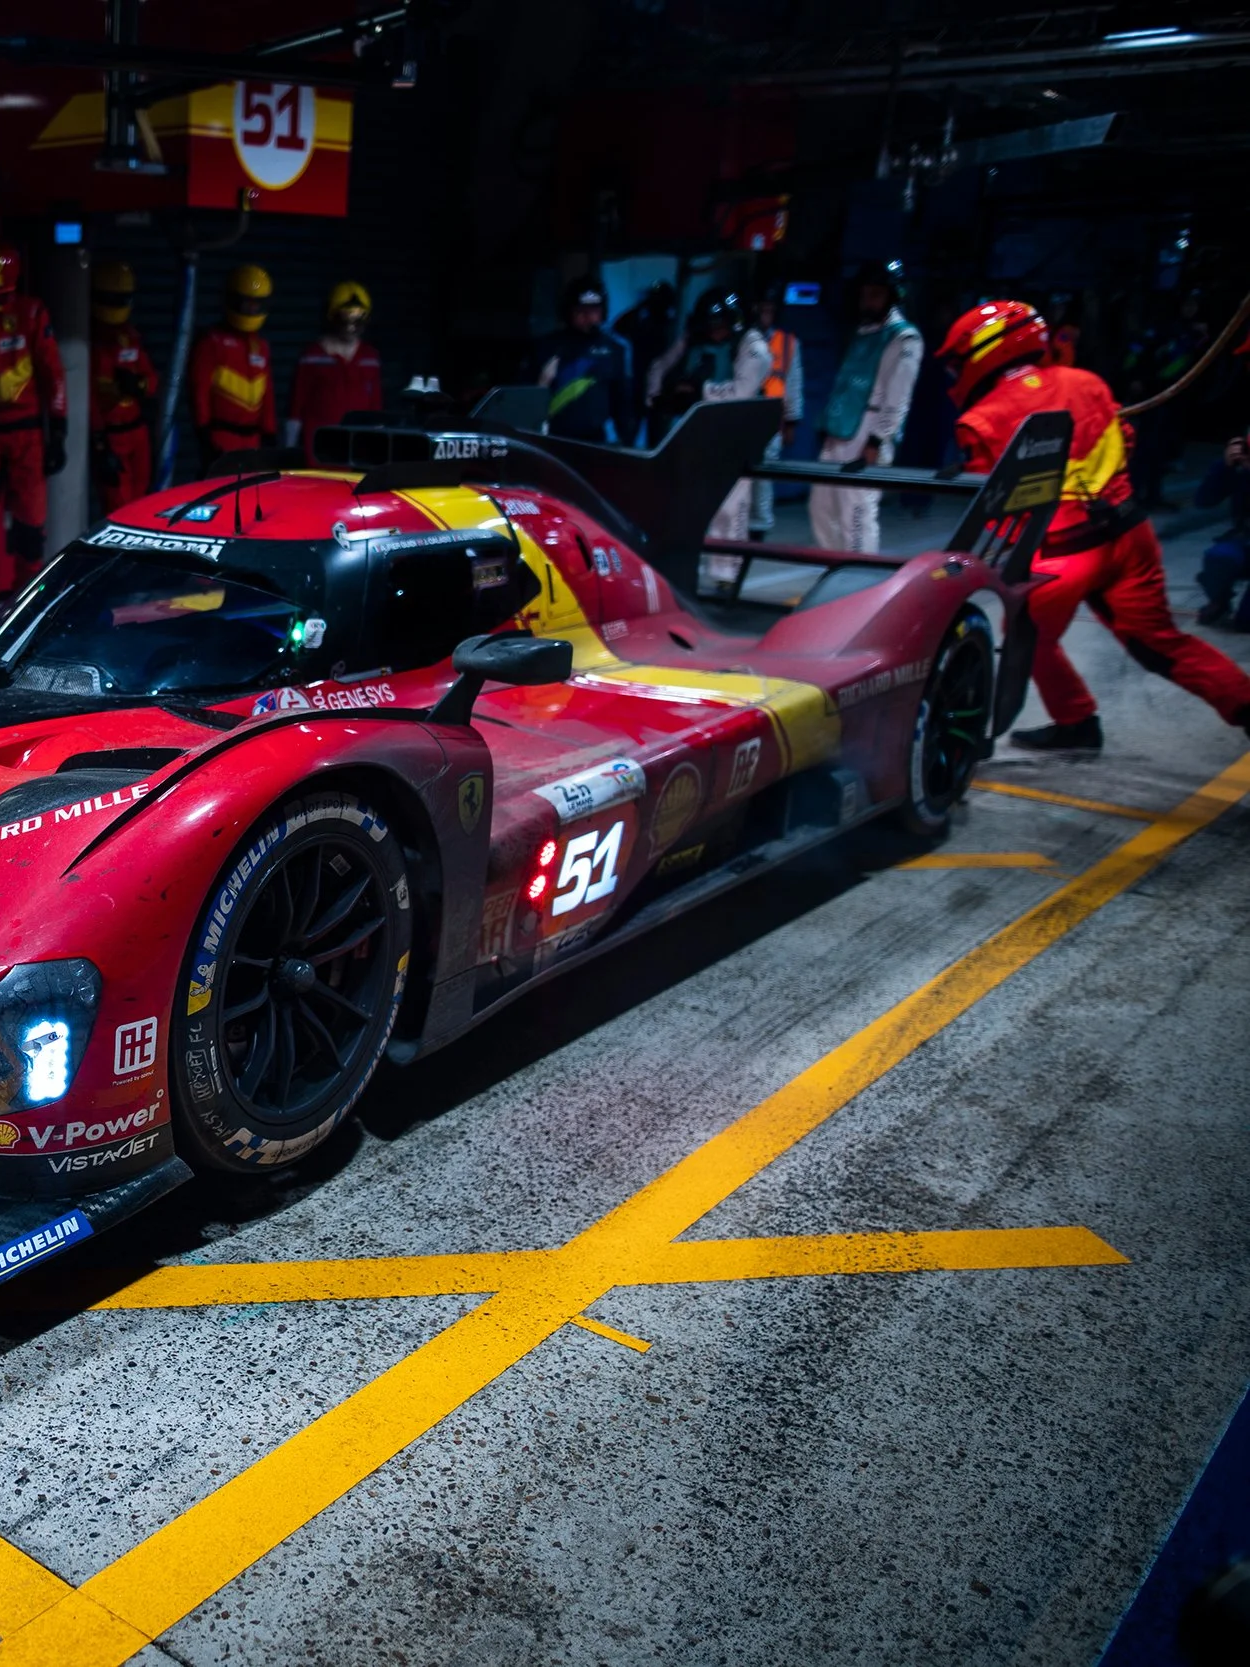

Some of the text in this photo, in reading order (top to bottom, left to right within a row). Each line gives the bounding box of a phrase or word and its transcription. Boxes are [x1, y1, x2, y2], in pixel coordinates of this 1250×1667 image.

[240, 83, 306, 151] 51
[434, 440, 480, 460] ADLER
[328, 683, 396, 710] GENESYS
[54, 783, 150, 823] MILLE
[322, 800, 351, 811] SPORT
[202, 825, 281, 956] MICHELIN
[552, 821, 625, 916] 51
[28, 1101, 161, 1149] V-Power
